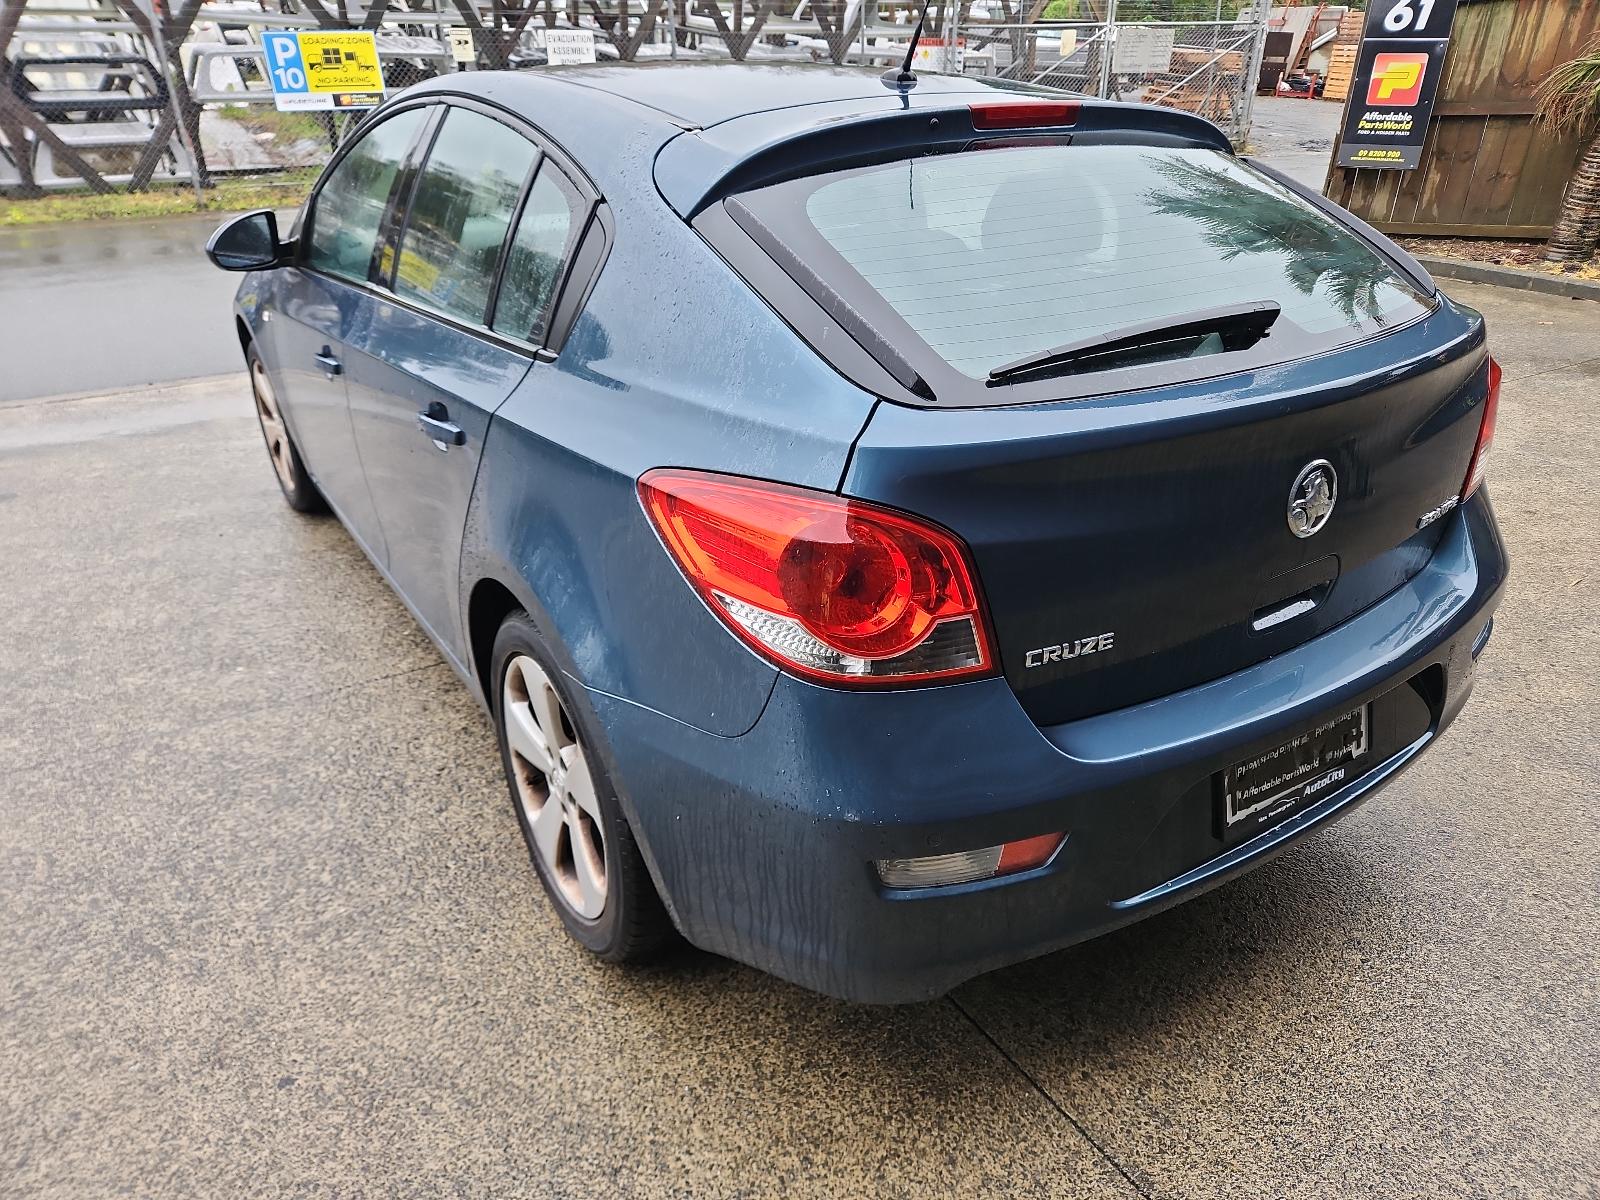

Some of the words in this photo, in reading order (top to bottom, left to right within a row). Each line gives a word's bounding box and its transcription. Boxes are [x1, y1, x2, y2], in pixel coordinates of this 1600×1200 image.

[1384, 0, 1435, 31] 61
[303, 37, 344, 45] LOADING
[547, 34, 592, 43] EVACUATION
[271, 37, 297, 67] P
[552, 46, 590, 55] ASSEMBLY
[273, 67, 305, 90] 10
[1362, 111, 1413, 121] Affordable
[1358, 120, 1413, 130] PartsWorld
[1358, 149, 1368, 157] 09
[1387, 150, 1401, 158] 900
[1025, 632, 1115, 668] CRUZE
[1303, 768, 1345, 798] AutoCity
